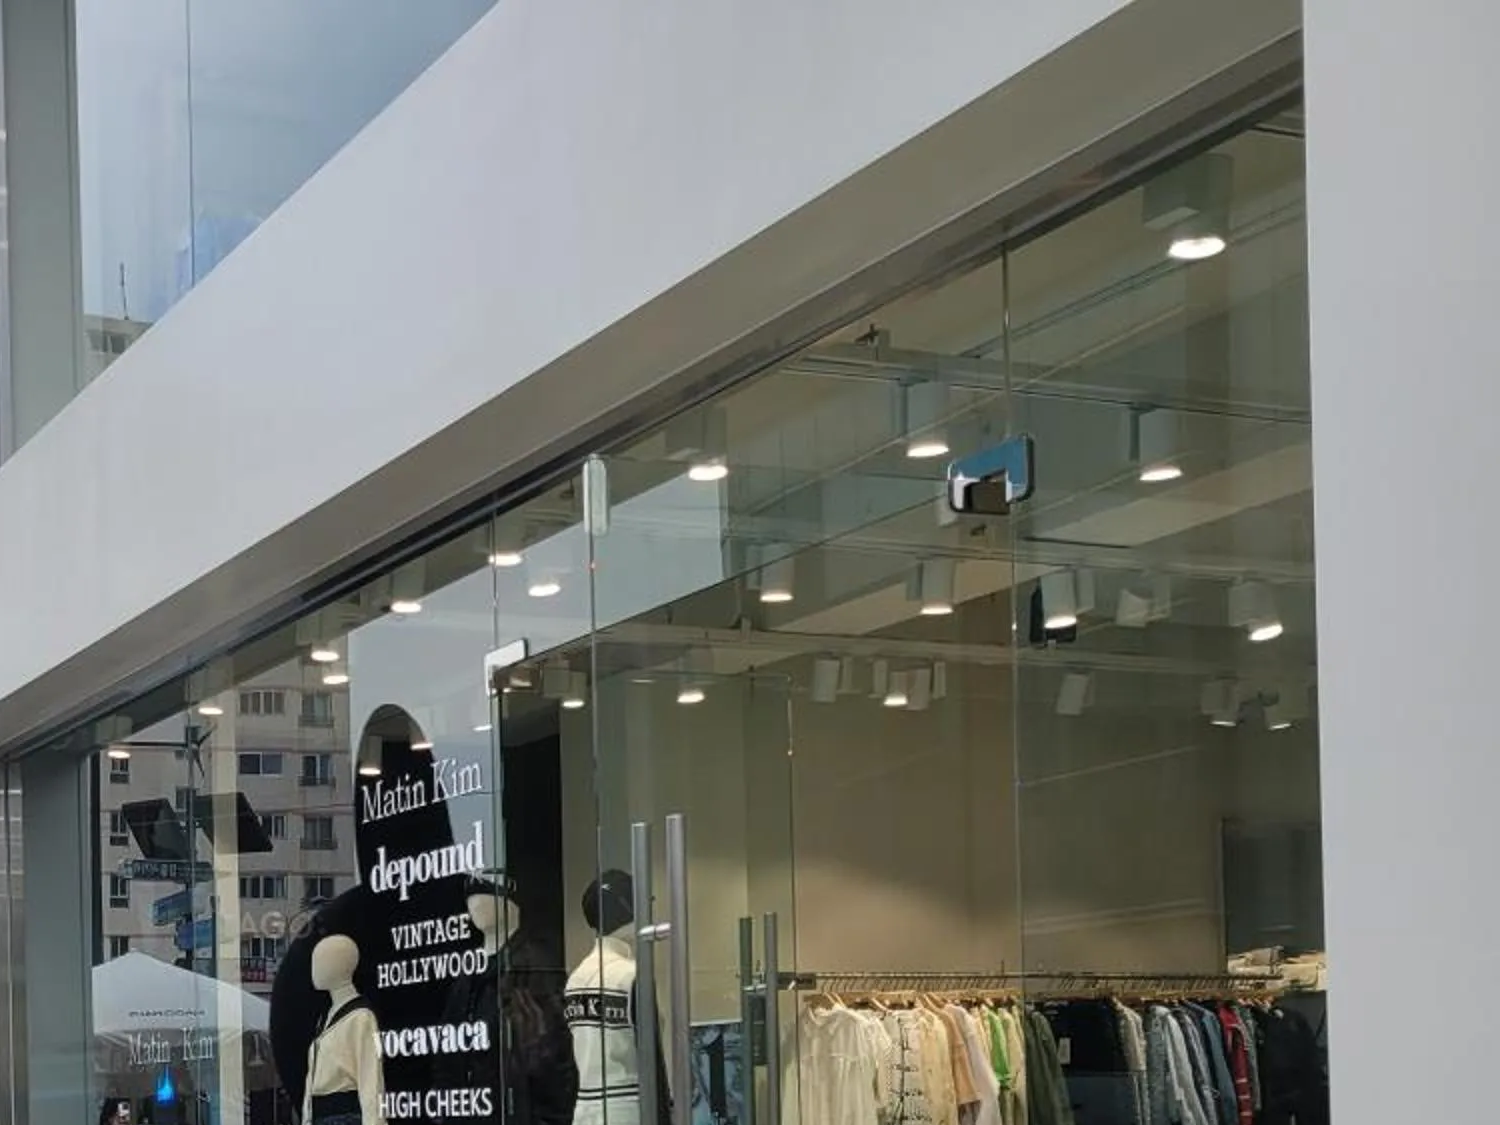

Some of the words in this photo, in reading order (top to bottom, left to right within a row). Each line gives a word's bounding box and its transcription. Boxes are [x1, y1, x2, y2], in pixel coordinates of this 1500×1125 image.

[362, 773, 427, 824] Matin
[430, 758, 482, 803] Kim
[370, 820, 485, 901] depound
[391, 913, 471, 950] VINTAGE
[377, 948, 489, 988] HOLLYWOOD
[588, 998, 625, 1017] Km
[128, 1032, 171, 1066] Matin
[373, 1020, 490, 1058] vocavaca
[378, 1091, 420, 1119] HIGH
[425, 1088, 493, 1118] CHEEKS
